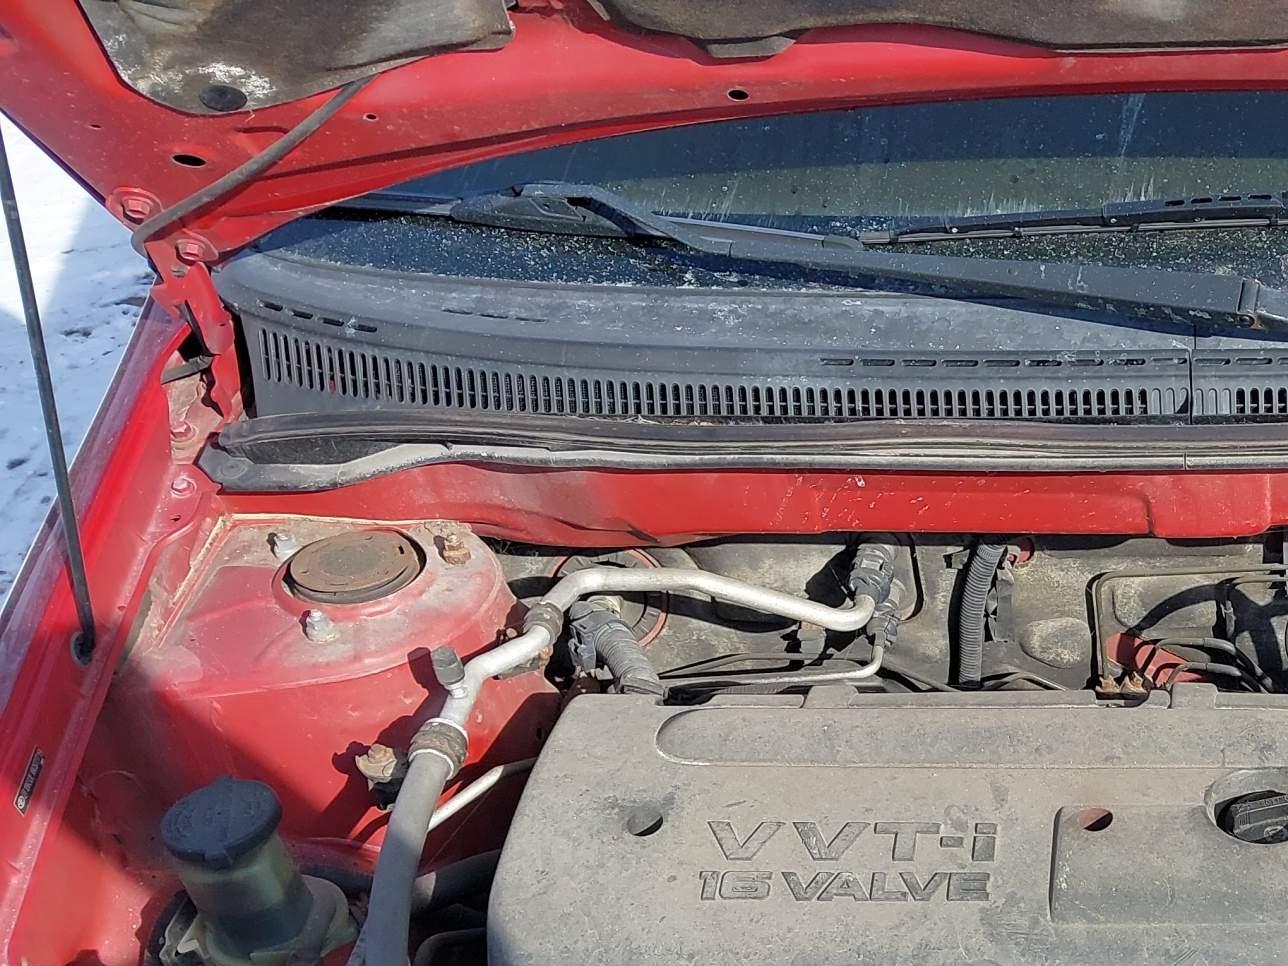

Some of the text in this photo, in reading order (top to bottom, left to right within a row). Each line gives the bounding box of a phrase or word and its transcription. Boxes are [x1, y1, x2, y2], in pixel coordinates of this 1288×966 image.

[706, 820, 998, 861] VVT-i
[699, 870, 992, 901] 16 VALVE
